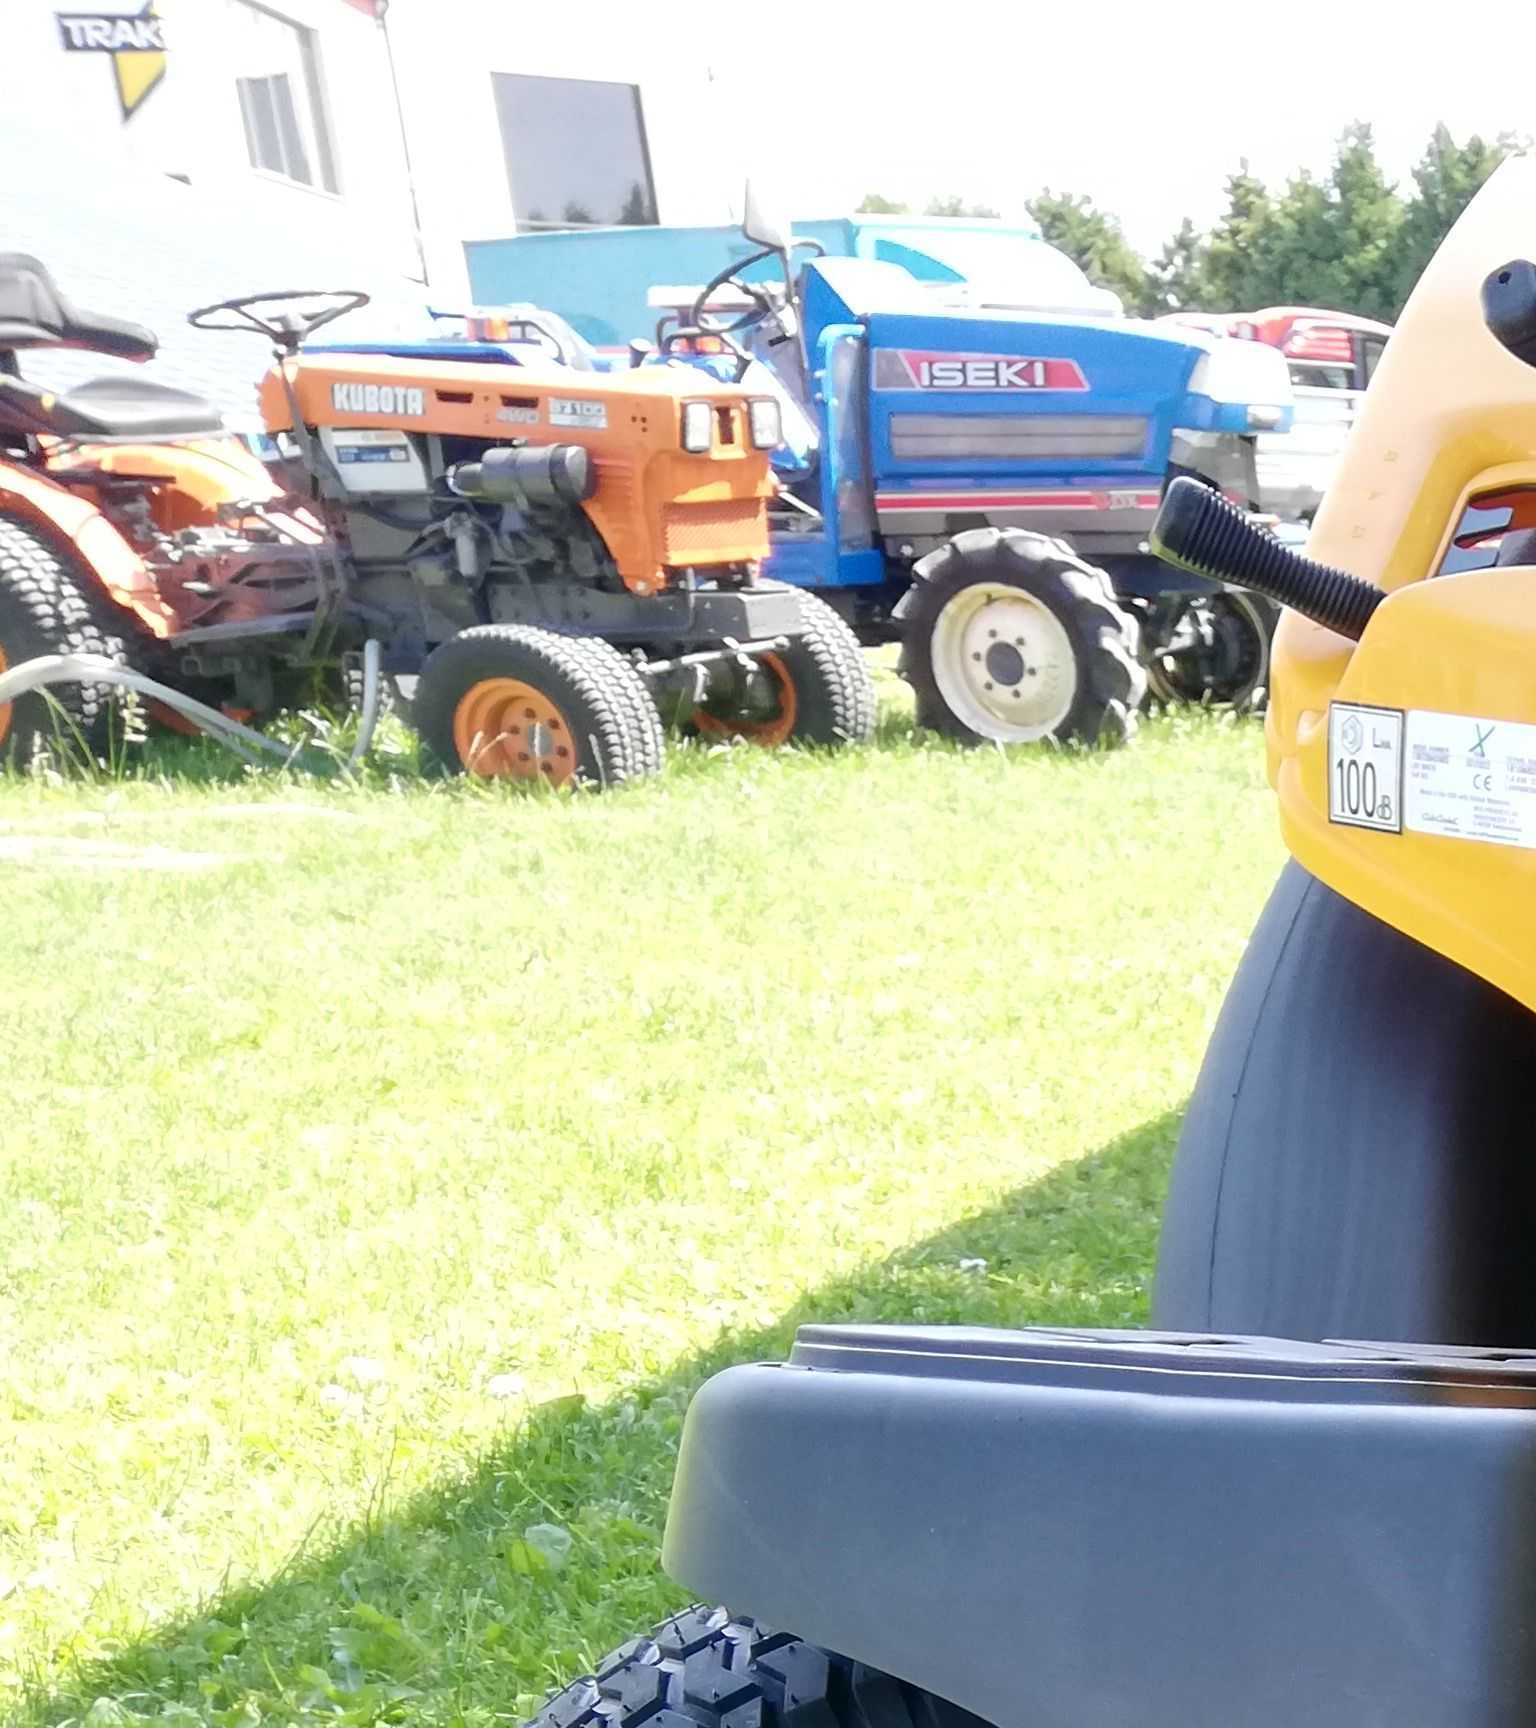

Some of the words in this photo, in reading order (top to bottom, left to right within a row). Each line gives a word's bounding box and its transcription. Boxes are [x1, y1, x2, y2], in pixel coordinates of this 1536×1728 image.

[60, 18, 166, 49] TRAK
[919, 360, 1046, 387] ISEKI
[332, 383, 425, 416] KUBOTA
[1336, 757, 1377, 818] 100
